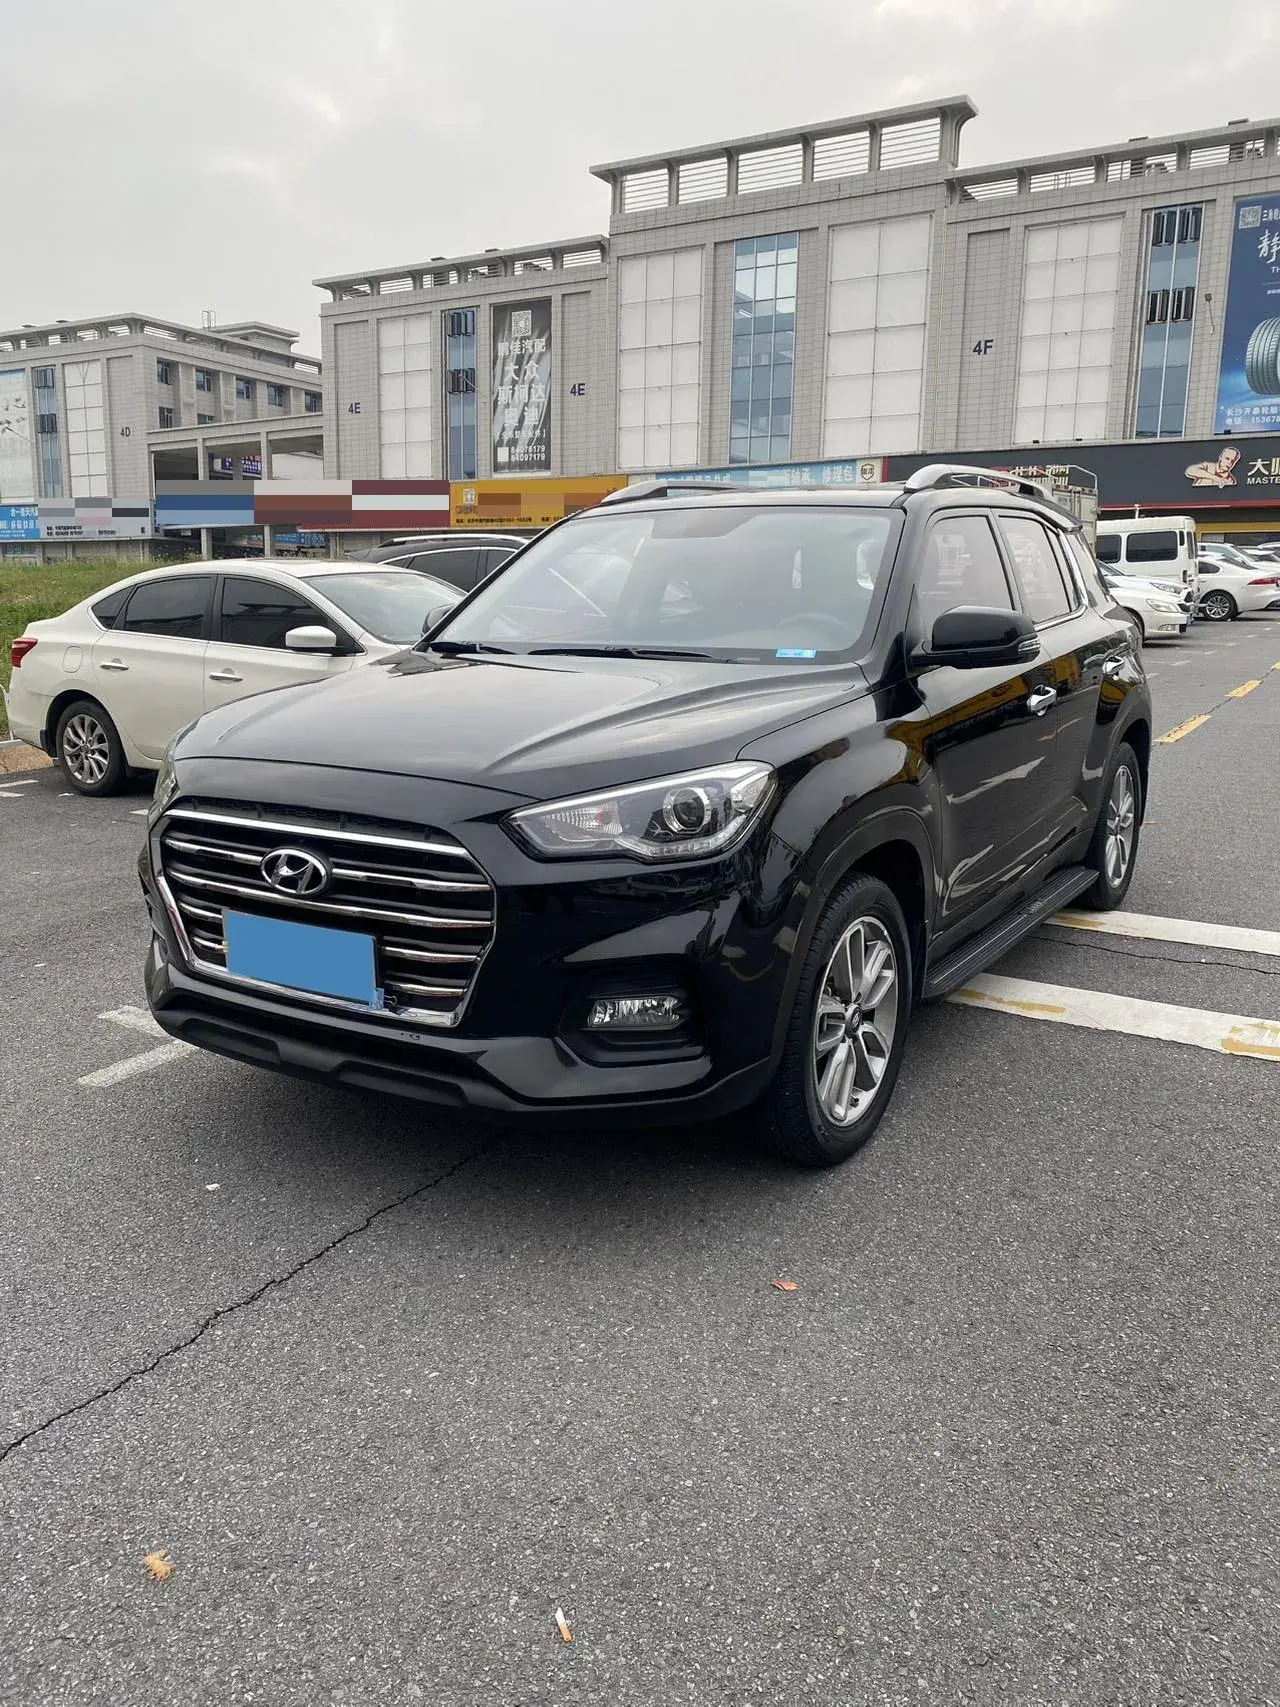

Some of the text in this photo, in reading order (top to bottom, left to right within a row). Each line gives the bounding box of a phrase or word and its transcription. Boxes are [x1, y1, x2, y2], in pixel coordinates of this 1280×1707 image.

[973, 339, 994, 355] 4F
[504, 360, 539, 381] 大众
[497, 382, 546, 404] 斯柯达
[570, 383, 586, 396] 4E
[348, 402, 361, 414] 4E
[120, 426, 131, 437] 4D
